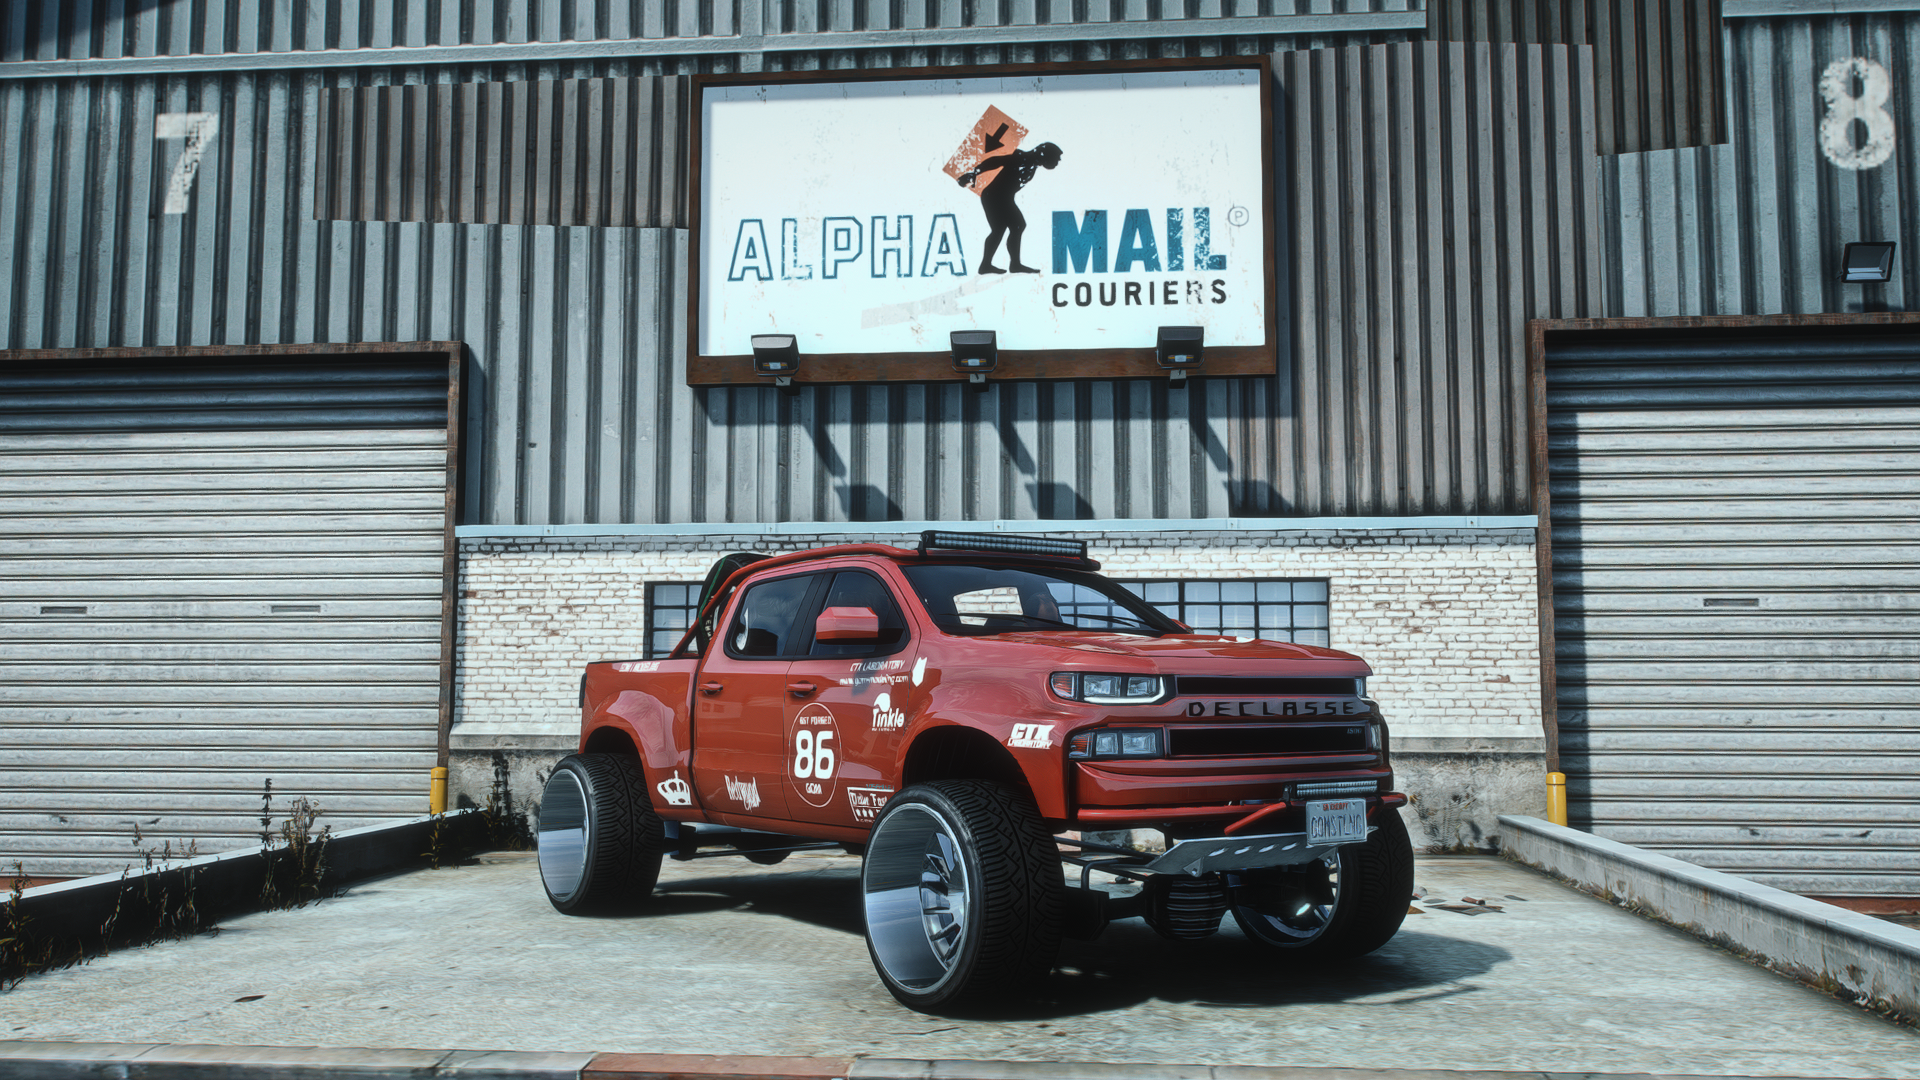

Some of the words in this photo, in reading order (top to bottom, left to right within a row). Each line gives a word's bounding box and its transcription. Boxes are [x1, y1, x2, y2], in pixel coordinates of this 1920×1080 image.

[1818, 56, 1897, 171] 8
[155, 112, 220, 215] 7
[727, 213, 969, 283] ALPHA
[1051, 206, 1227, 275] MAIL
[1051, 278, 1227, 308] COURIERS
[872, 707, 905, 728] Tinkle
[1188, 701, 1354, 717] DECLASSE
[794, 730, 835, 779] 86
